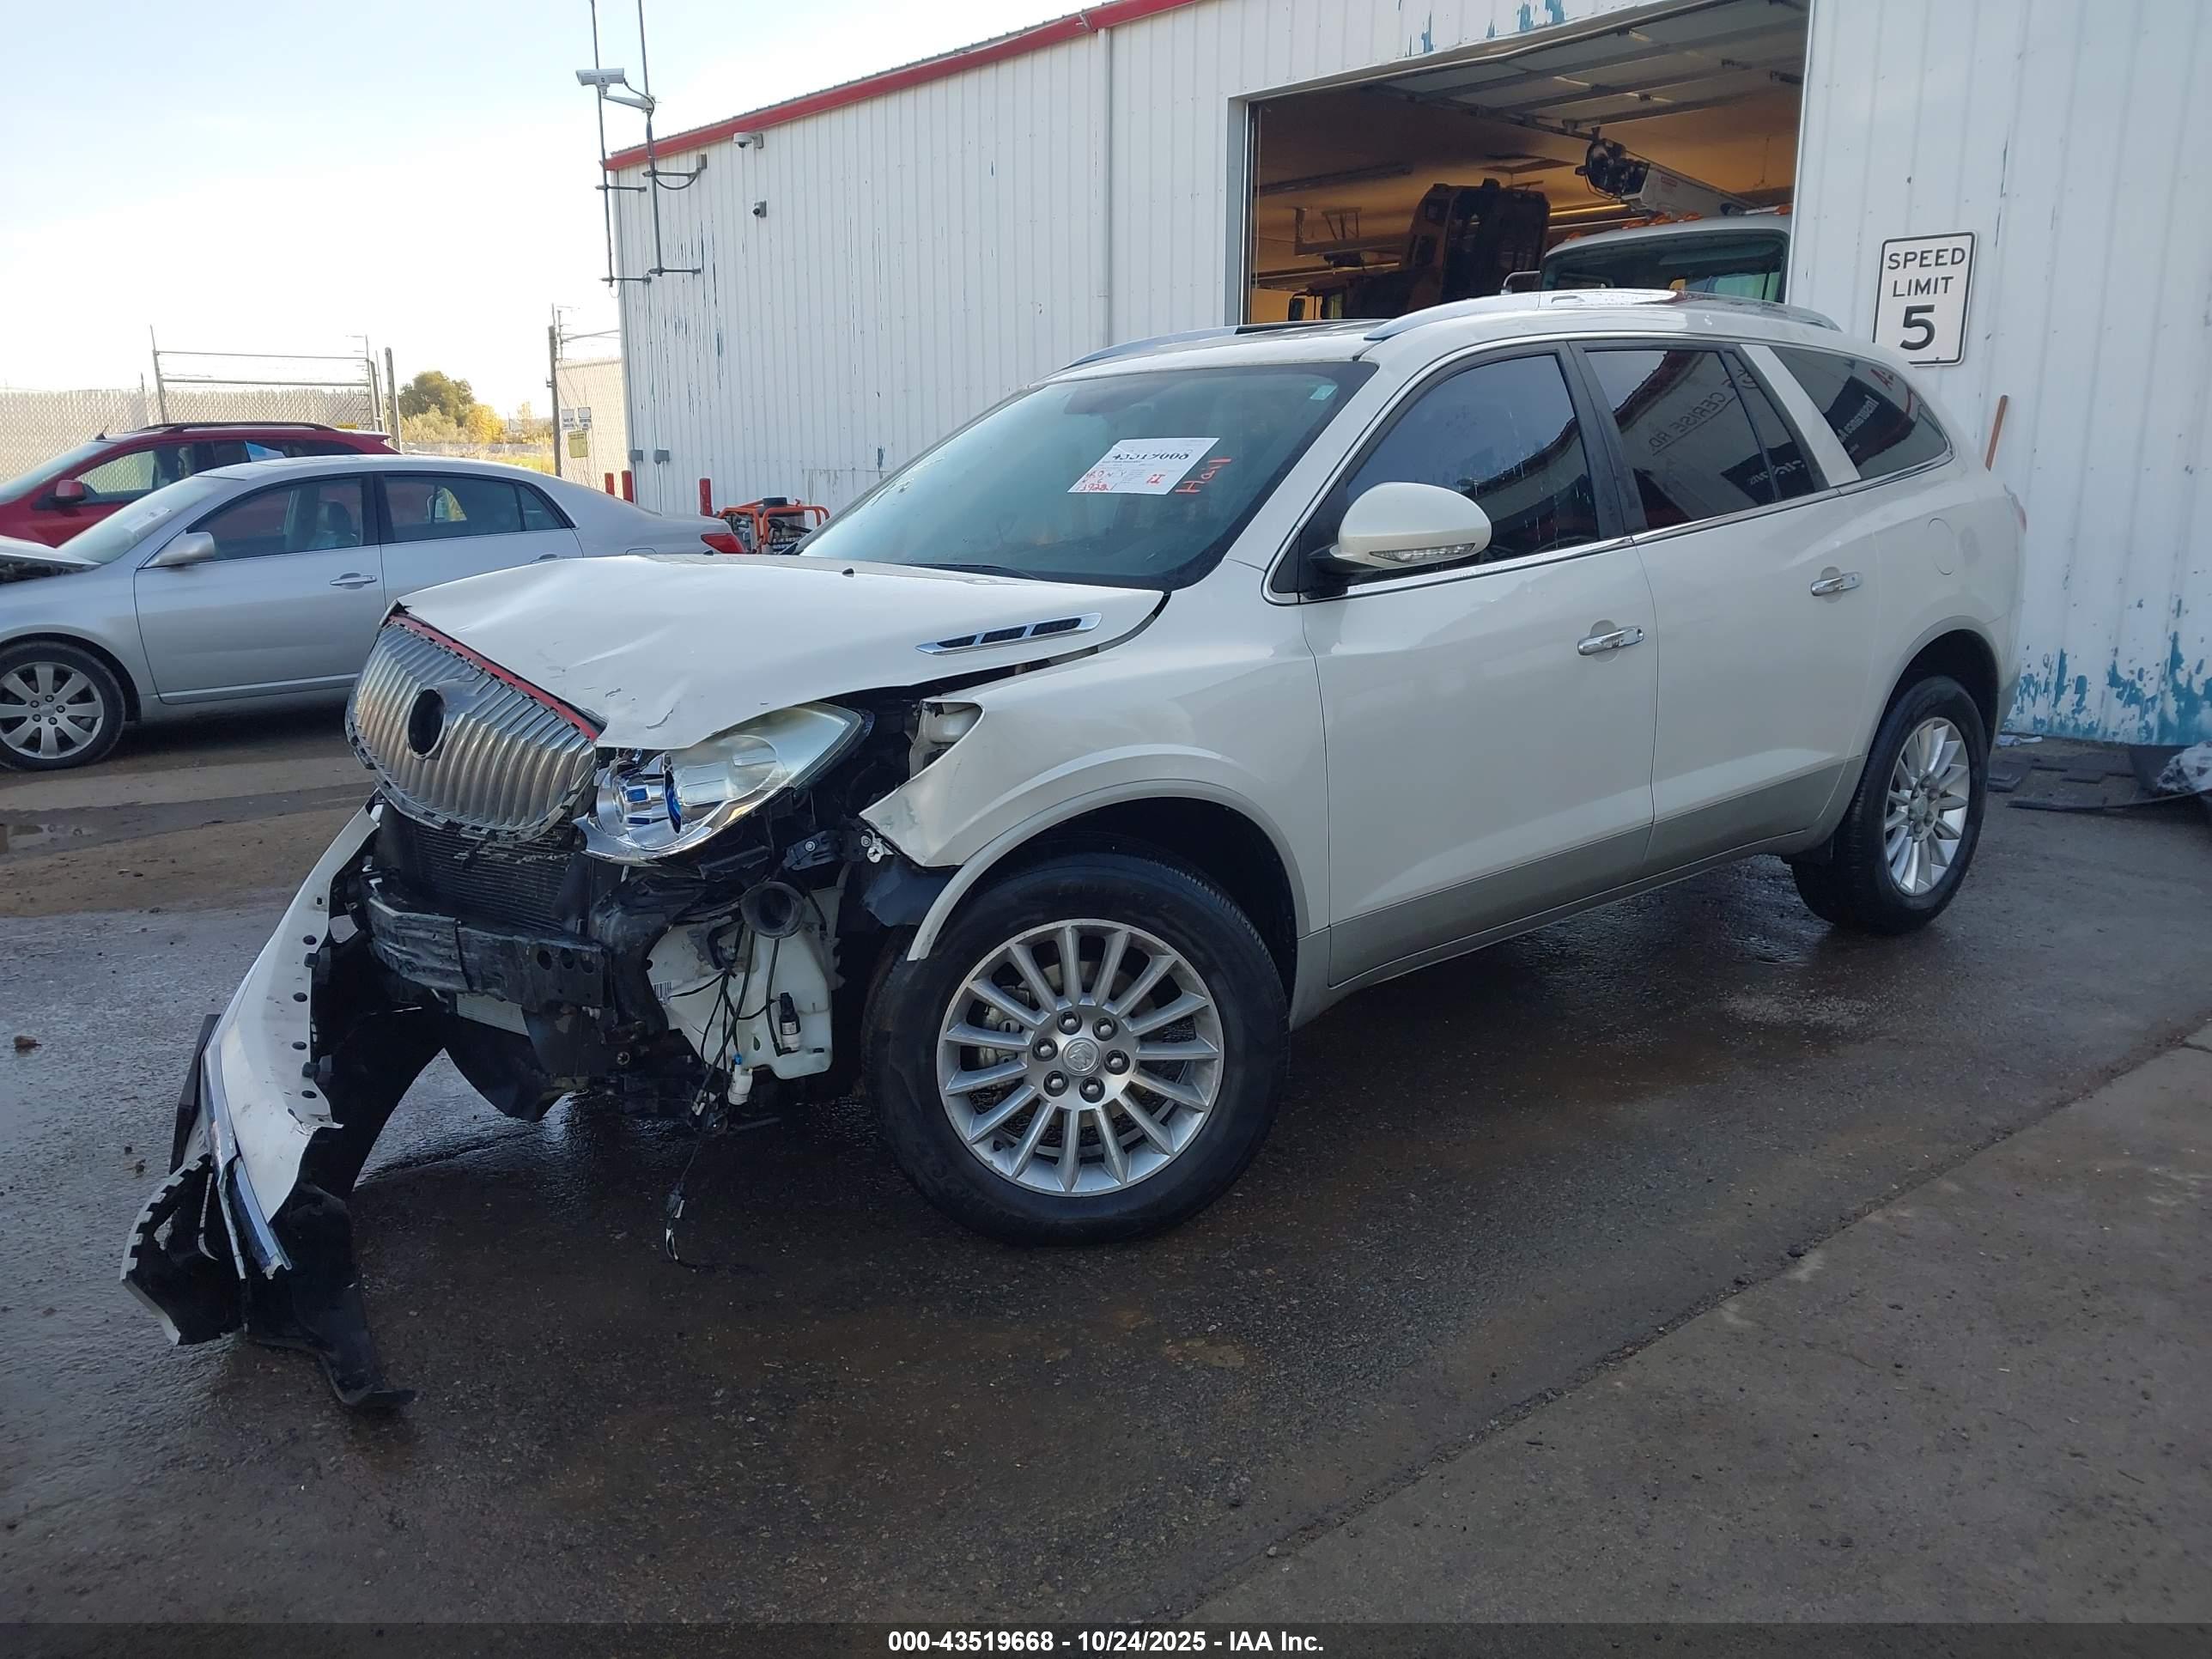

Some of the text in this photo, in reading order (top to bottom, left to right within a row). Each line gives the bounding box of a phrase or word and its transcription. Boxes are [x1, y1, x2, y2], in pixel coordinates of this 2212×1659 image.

[1887, 247, 1966, 270] SPEED
[1893, 276, 1954, 297] LIMIT
[1899, 304, 1936, 350] 5
